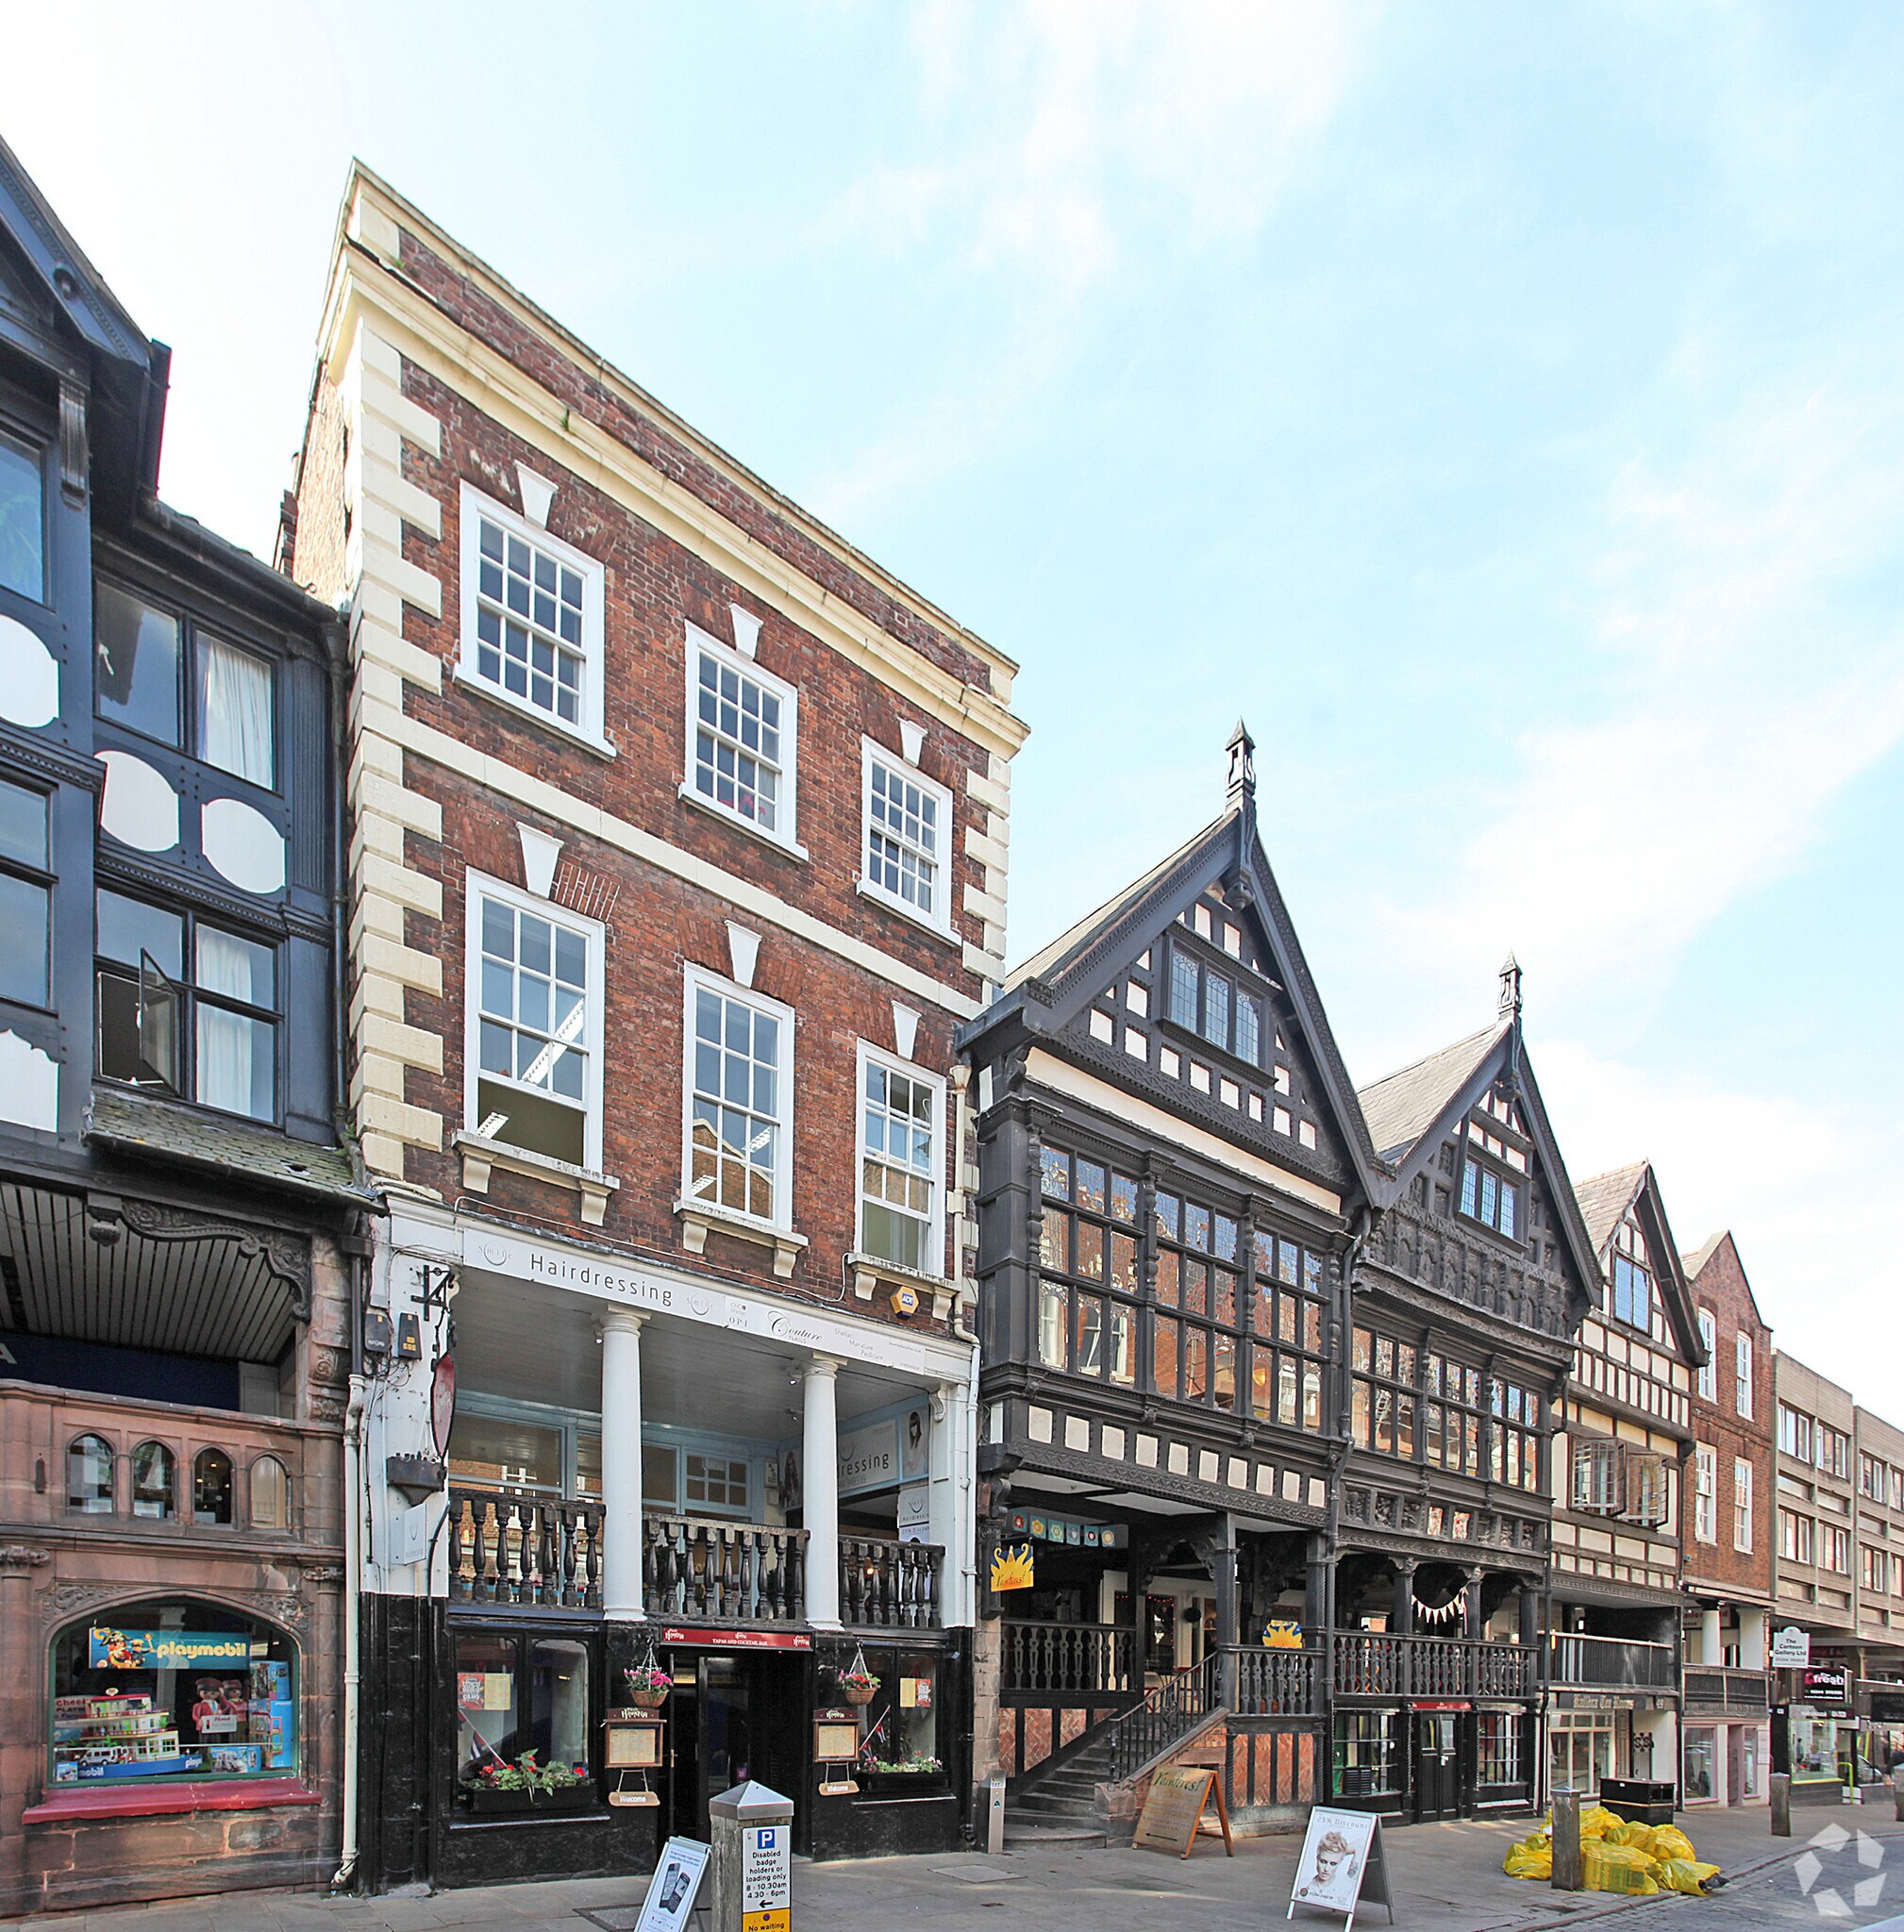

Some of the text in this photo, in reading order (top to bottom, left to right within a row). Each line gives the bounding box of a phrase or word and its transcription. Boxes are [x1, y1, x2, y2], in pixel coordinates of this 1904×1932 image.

[530, 1254, 673, 1307] Hairdressing
[766, 1310, 824, 1341] Couture
[840, 1453, 890, 1476] ressing
[157, 1641, 247, 1659] playmobil
[752, 1850, 781, 1858] Disabled
[747, 1890, 765, 1899] 4.30
[758, 1882, 787, 1890] 10.30am
